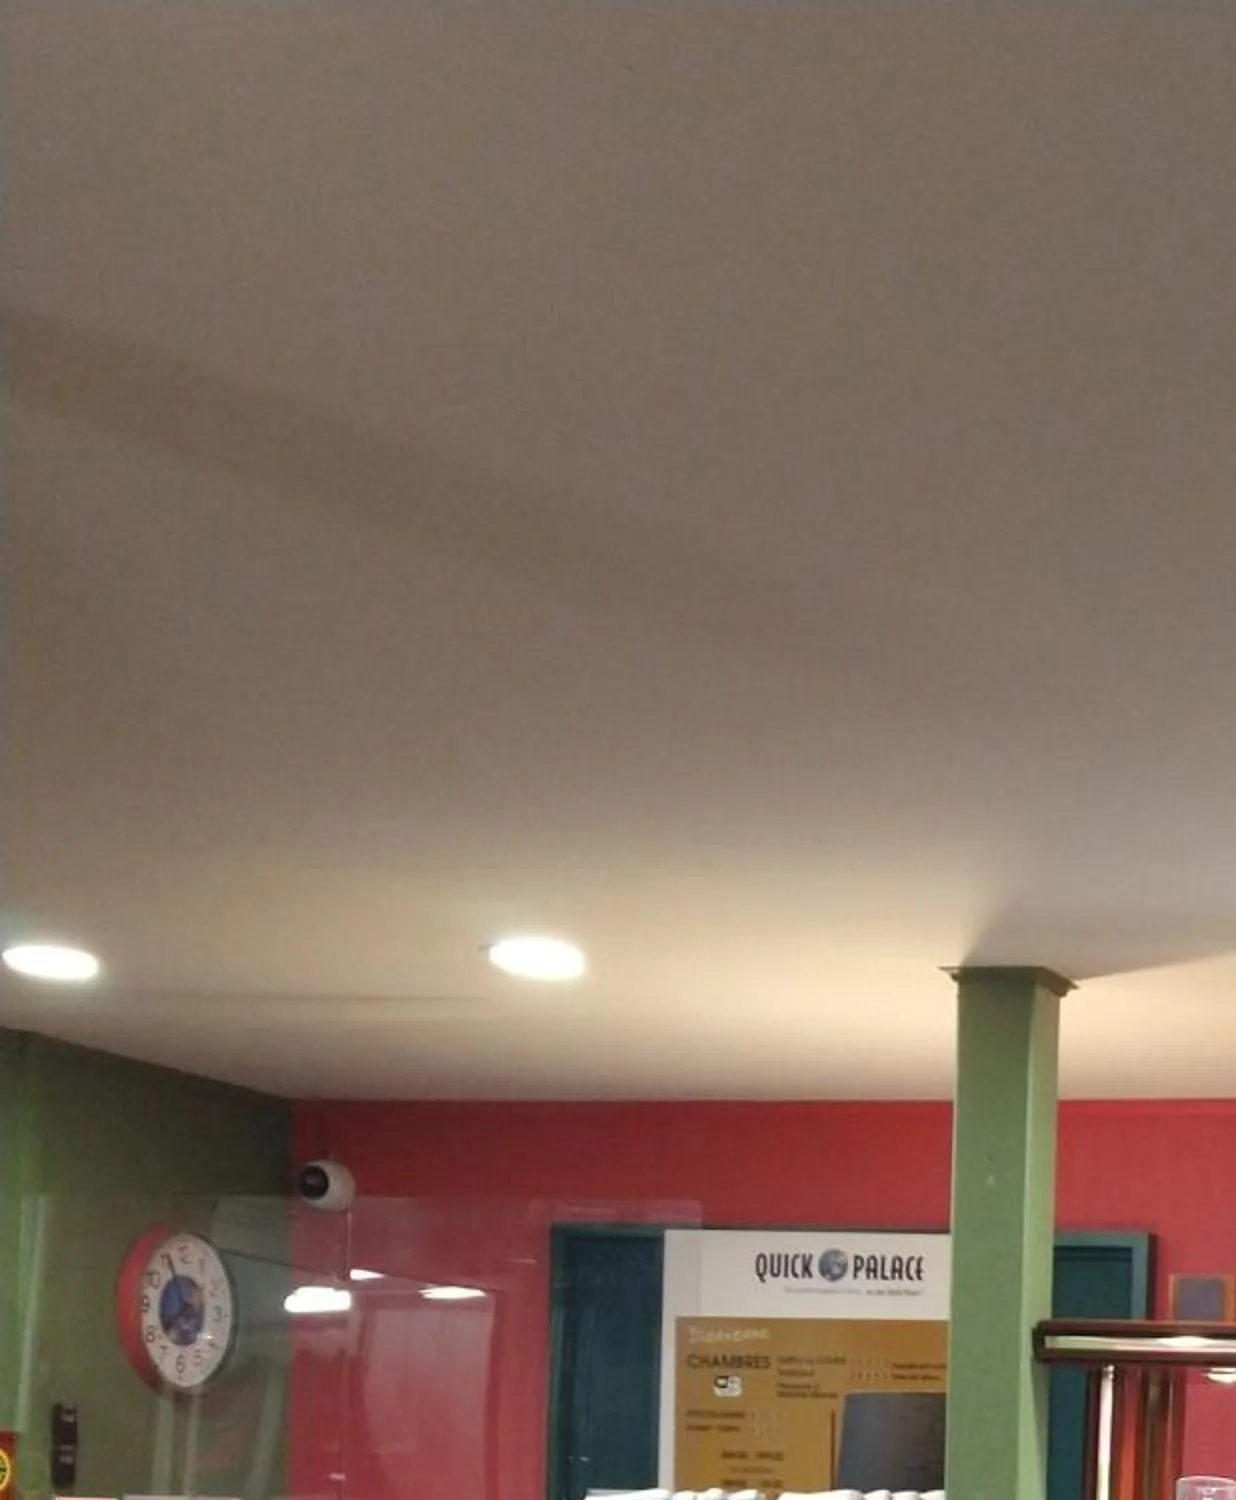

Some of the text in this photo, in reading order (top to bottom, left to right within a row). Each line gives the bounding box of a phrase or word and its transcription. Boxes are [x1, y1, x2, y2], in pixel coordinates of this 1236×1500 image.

[755, 1253, 925, 1284] QUICK PALACE
[145, 1325, 157, 1344] 8
[687, 1353, 772, 1370] CHAMBRES
